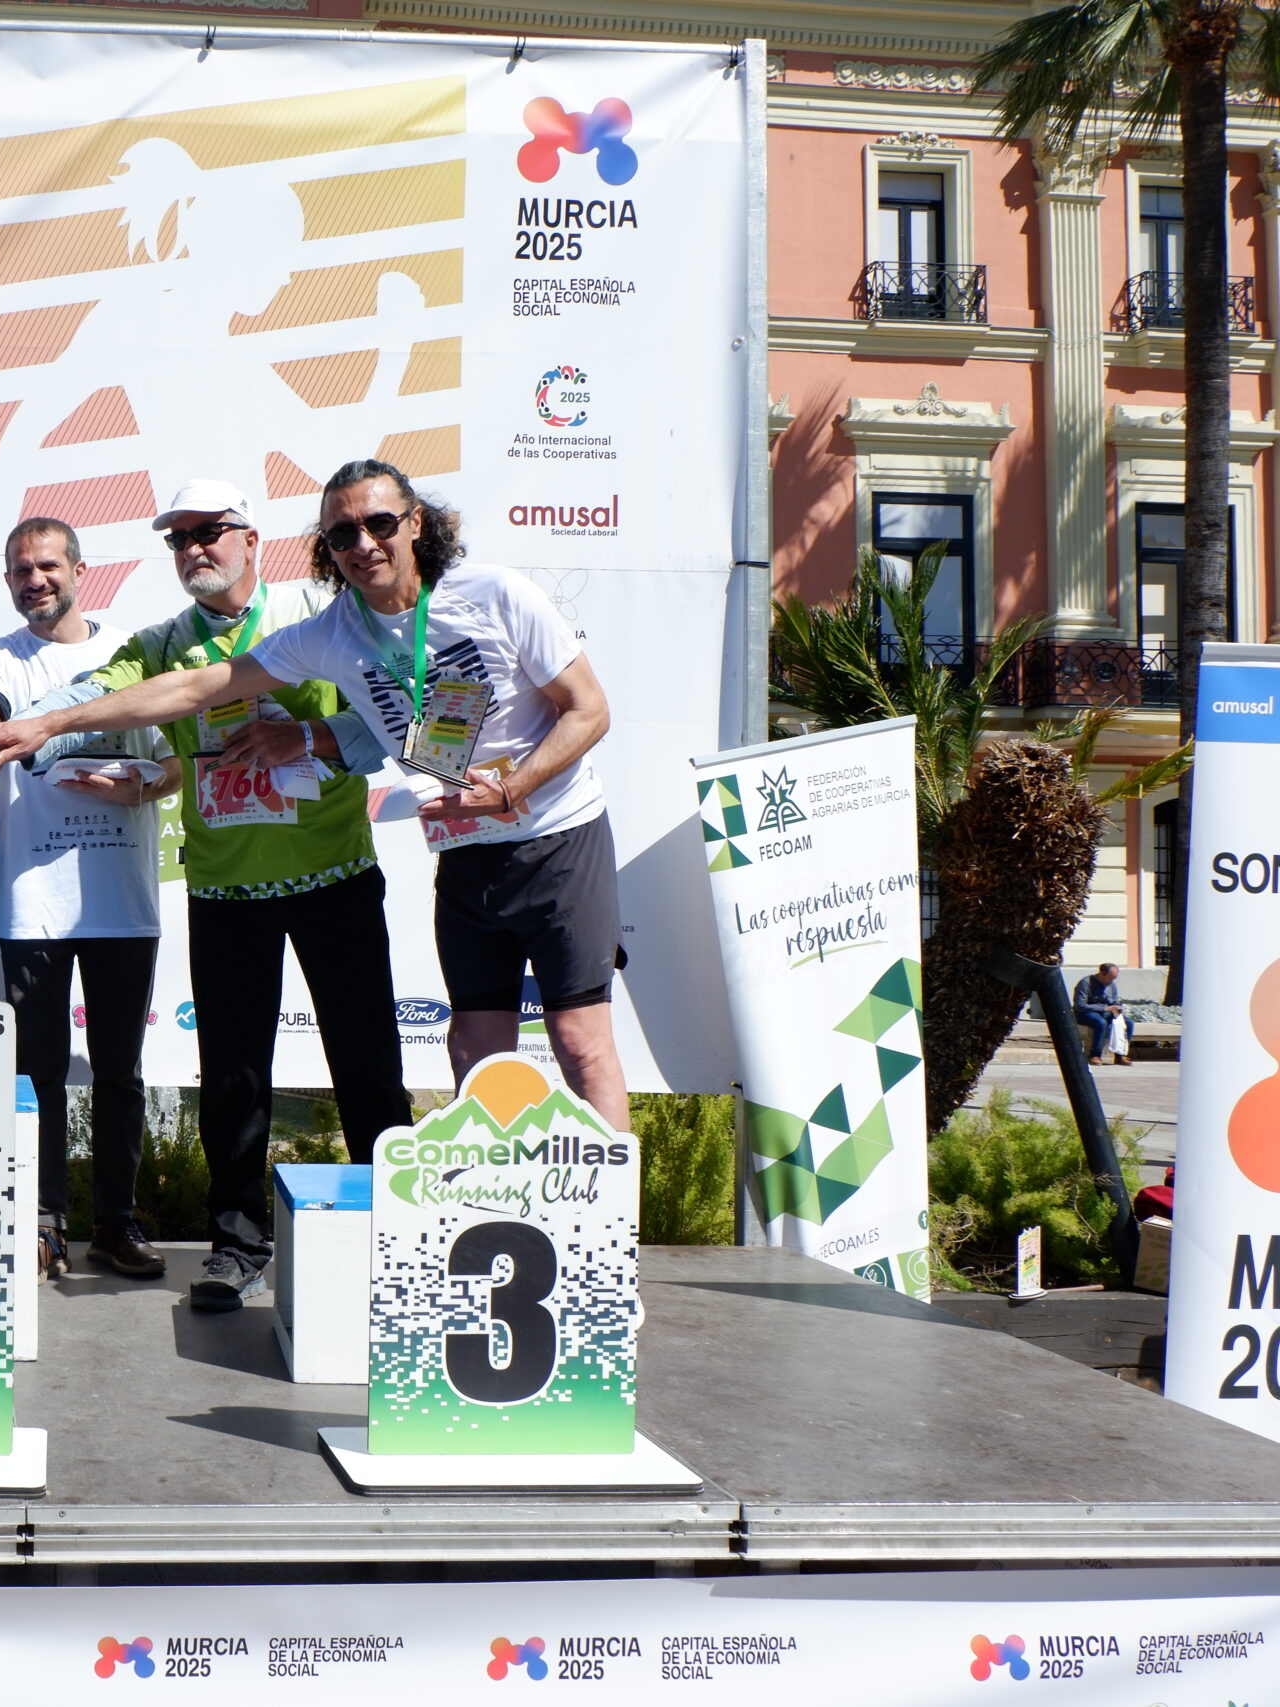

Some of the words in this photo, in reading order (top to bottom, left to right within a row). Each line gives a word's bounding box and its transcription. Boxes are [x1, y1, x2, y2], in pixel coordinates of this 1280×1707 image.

[517, 197, 638, 228] MURCIA
[515, 231, 582, 261] 2025
[513, 278, 566, 291] CAPITAL
[570, 277, 636, 293] ESPAÑOLA
[513, 292, 530, 304] DE
[534, 292, 550, 304] LA
[513, 304, 561, 316] SOCIAL
[560, 392, 590, 403] 2025
[513, 434, 535, 445] Año
[538, 434, 611, 446] Internacional
[507, 447, 520, 458] de
[524, 448, 539, 458] las
[542, 449, 617, 461] Cooperativas
[509, 494, 618, 527] amusal
[551, 528, 586, 537] Sociedad
[588, 528, 618, 537] Laboral
[1212, 696, 1273, 715] amusal
[216, 769, 274, 800] 760
[807, 765, 866, 787] FEDERACIÓN
[809, 791, 824, 803] DE
[825, 776, 891, 800] COOPERATIVAS
[811, 801, 859, 819] AGRARIAS
[861, 797, 873, 808] DE
[874, 788, 911, 805] MURCIA
[759, 834, 813, 862] FECOAM
[734, 902, 770, 935] Las
[772, 881, 875, 929] cooperativas
[786, 902, 888, 963] respuesta
[396, 1001, 439, 1021] Ford
[384, 1135, 628, 1166] ComeMillas
[421, 1167, 531, 1218] Running
[541, 1167, 598, 1204] Club
[447, 1221, 558, 1403] 3
[166, 1637, 249, 1655] MURCIA
[269, 1637, 326, 1649] CAPITAL
[330, 1634, 404, 1649] ESPAÑOLA
[559, 1637, 641, 1657] MURCIA
[661, 1637, 719, 1650] CAPITAL
[723, 1634, 797, 1650] ESPAÑOLA
[1039, 1636, 1120, 1657] MURCIA
[1139, 1635, 1193, 1649] CAPITAL
[1196, 1630, 1264, 1647] ESPAÑOLA
[269, 1650, 287, 1662] DE
[291, 1650, 309, 1662] LA
[661, 1651, 680, 1665] DE
[684, 1651, 702, 1665] LA
[1138, 1649, 1156, 1662] DE
[1159, 1648, 1175, 1661] LA
[165, 1658, 211, 1677] 2025
[268, 1663, 319, 1676] SOCIAL
[558, 1660, 604, 1680] 2025
[661, 1666, 713, 1679] SOCIAL
[1040, 1660, 1083, 1679] 2025
[1136, 1661, 1183, 1675] SOCIAL
